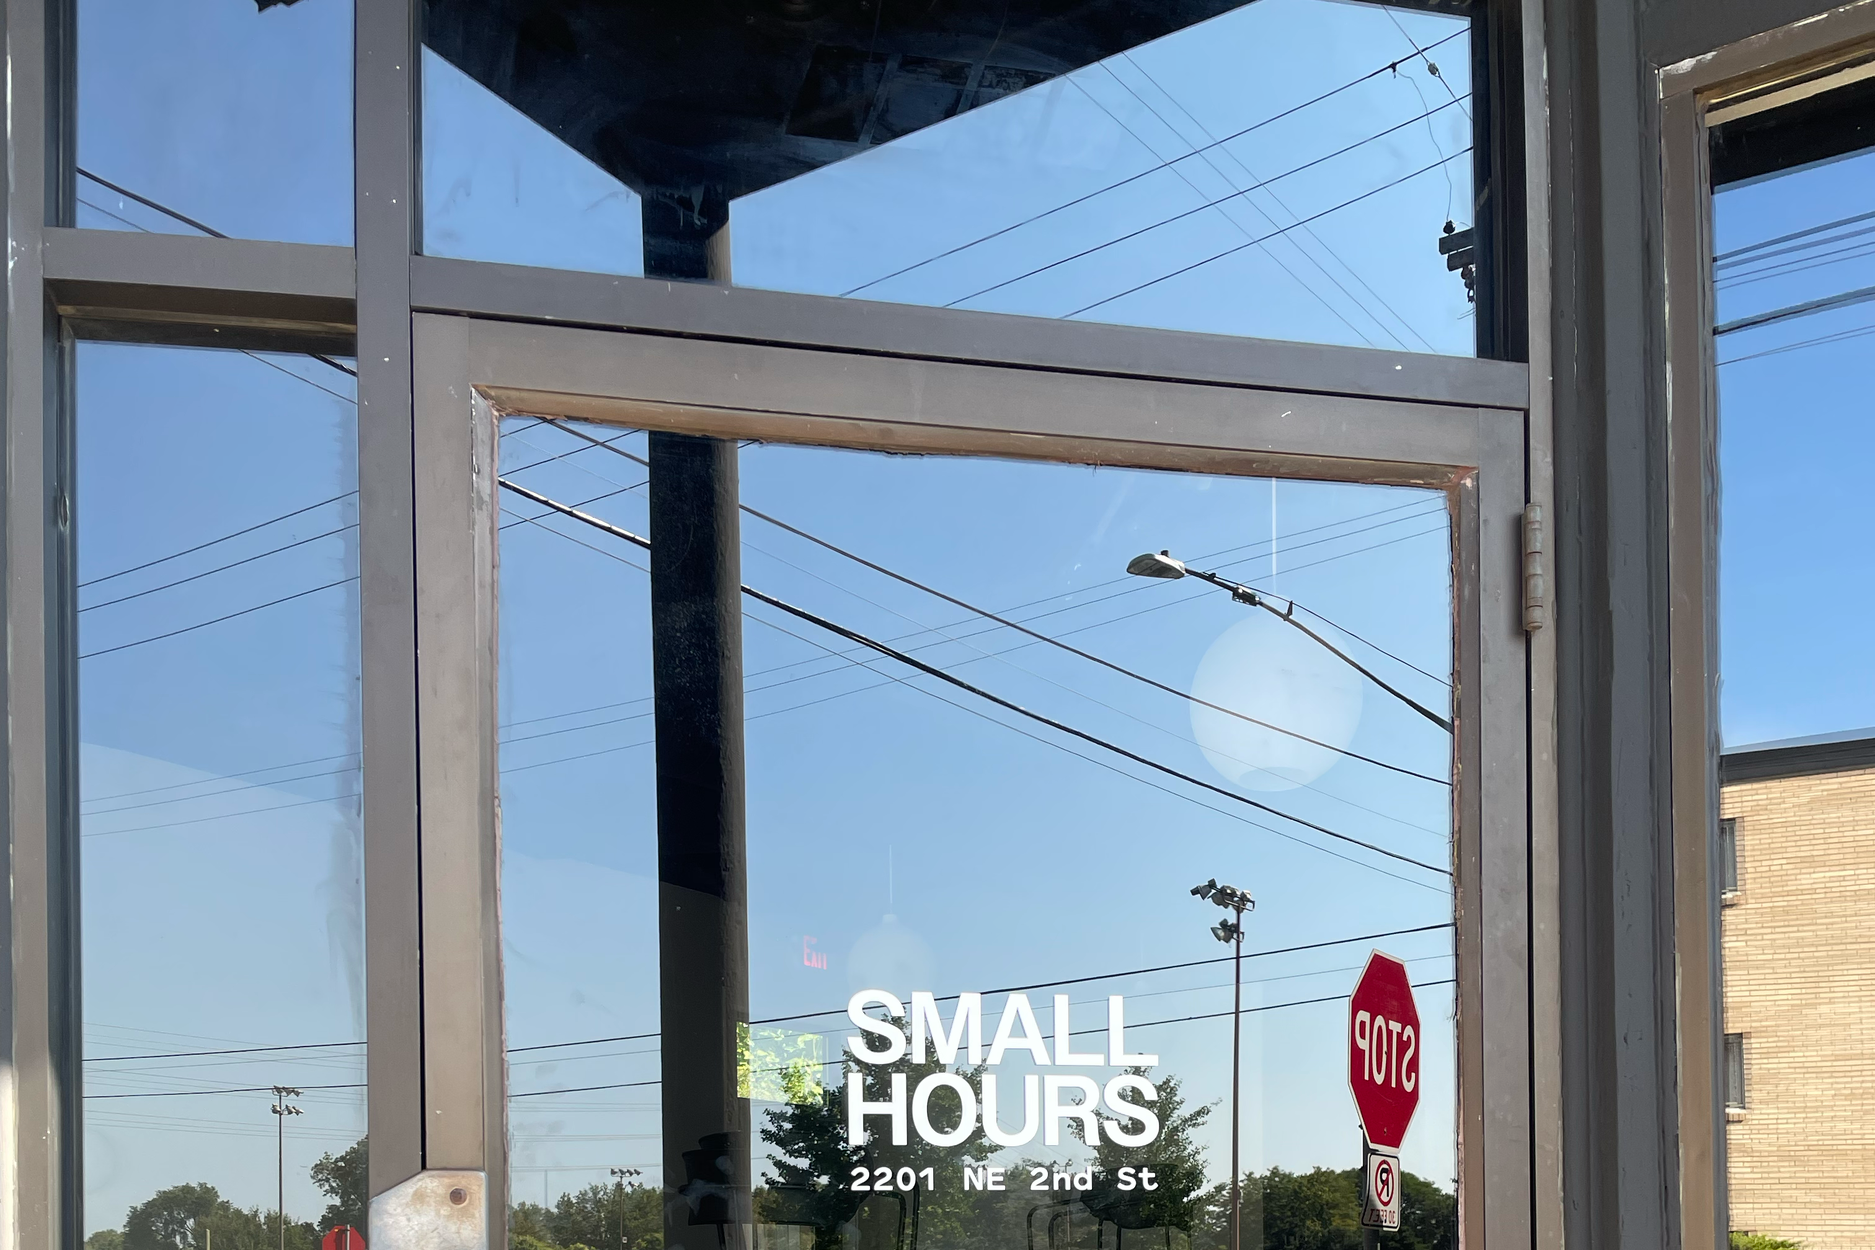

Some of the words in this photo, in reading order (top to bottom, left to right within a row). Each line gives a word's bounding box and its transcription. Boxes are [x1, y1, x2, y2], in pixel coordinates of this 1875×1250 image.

[847, 989, 1159, 1066] SMALL
[847, 1072, 1160, 1147] HOURS
[850, 1167, 935, 1191] 2201
[963, 1168, 1006, 1191] NE
[1030, 1167, 1094, 1191] 2nd
[1117, 1168, 1159, 1191] St
